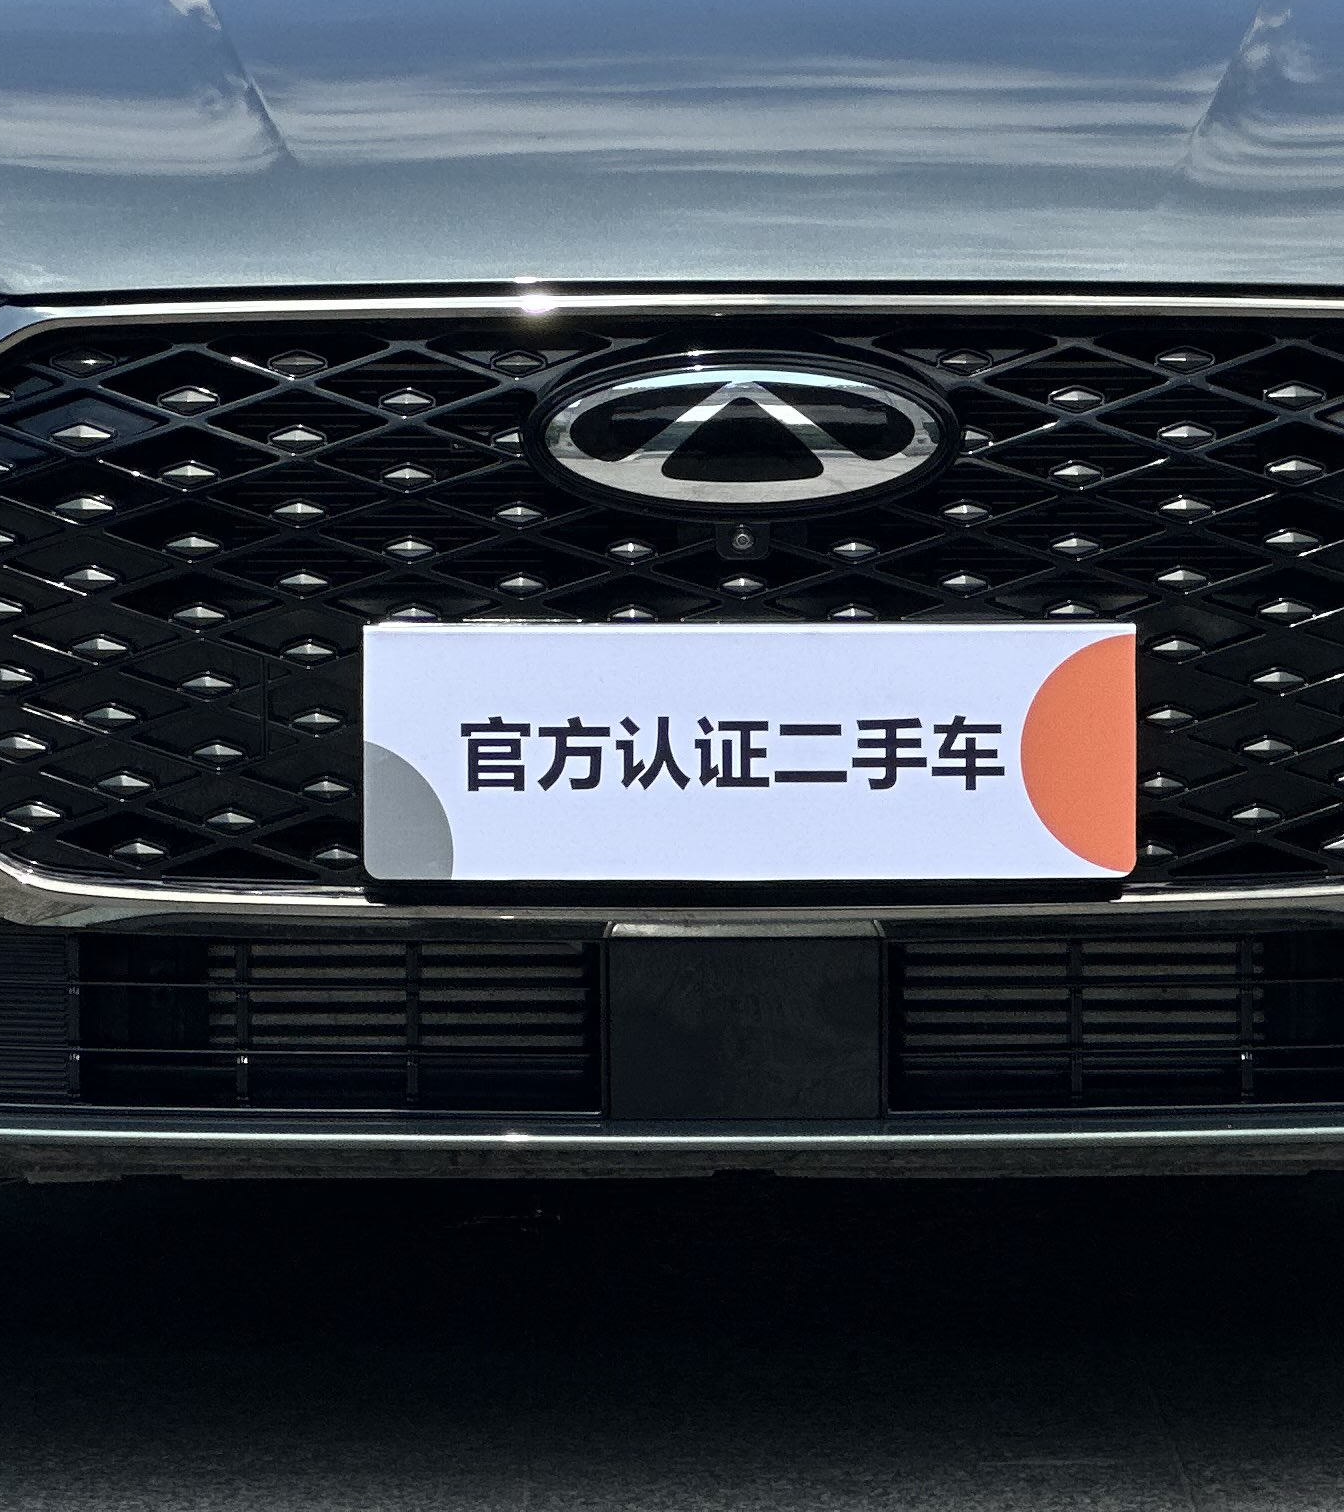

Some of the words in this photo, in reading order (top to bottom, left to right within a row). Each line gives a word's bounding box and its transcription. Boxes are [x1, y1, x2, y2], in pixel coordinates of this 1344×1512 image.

[460, 716, 1006, 791] 官方认证二手车
